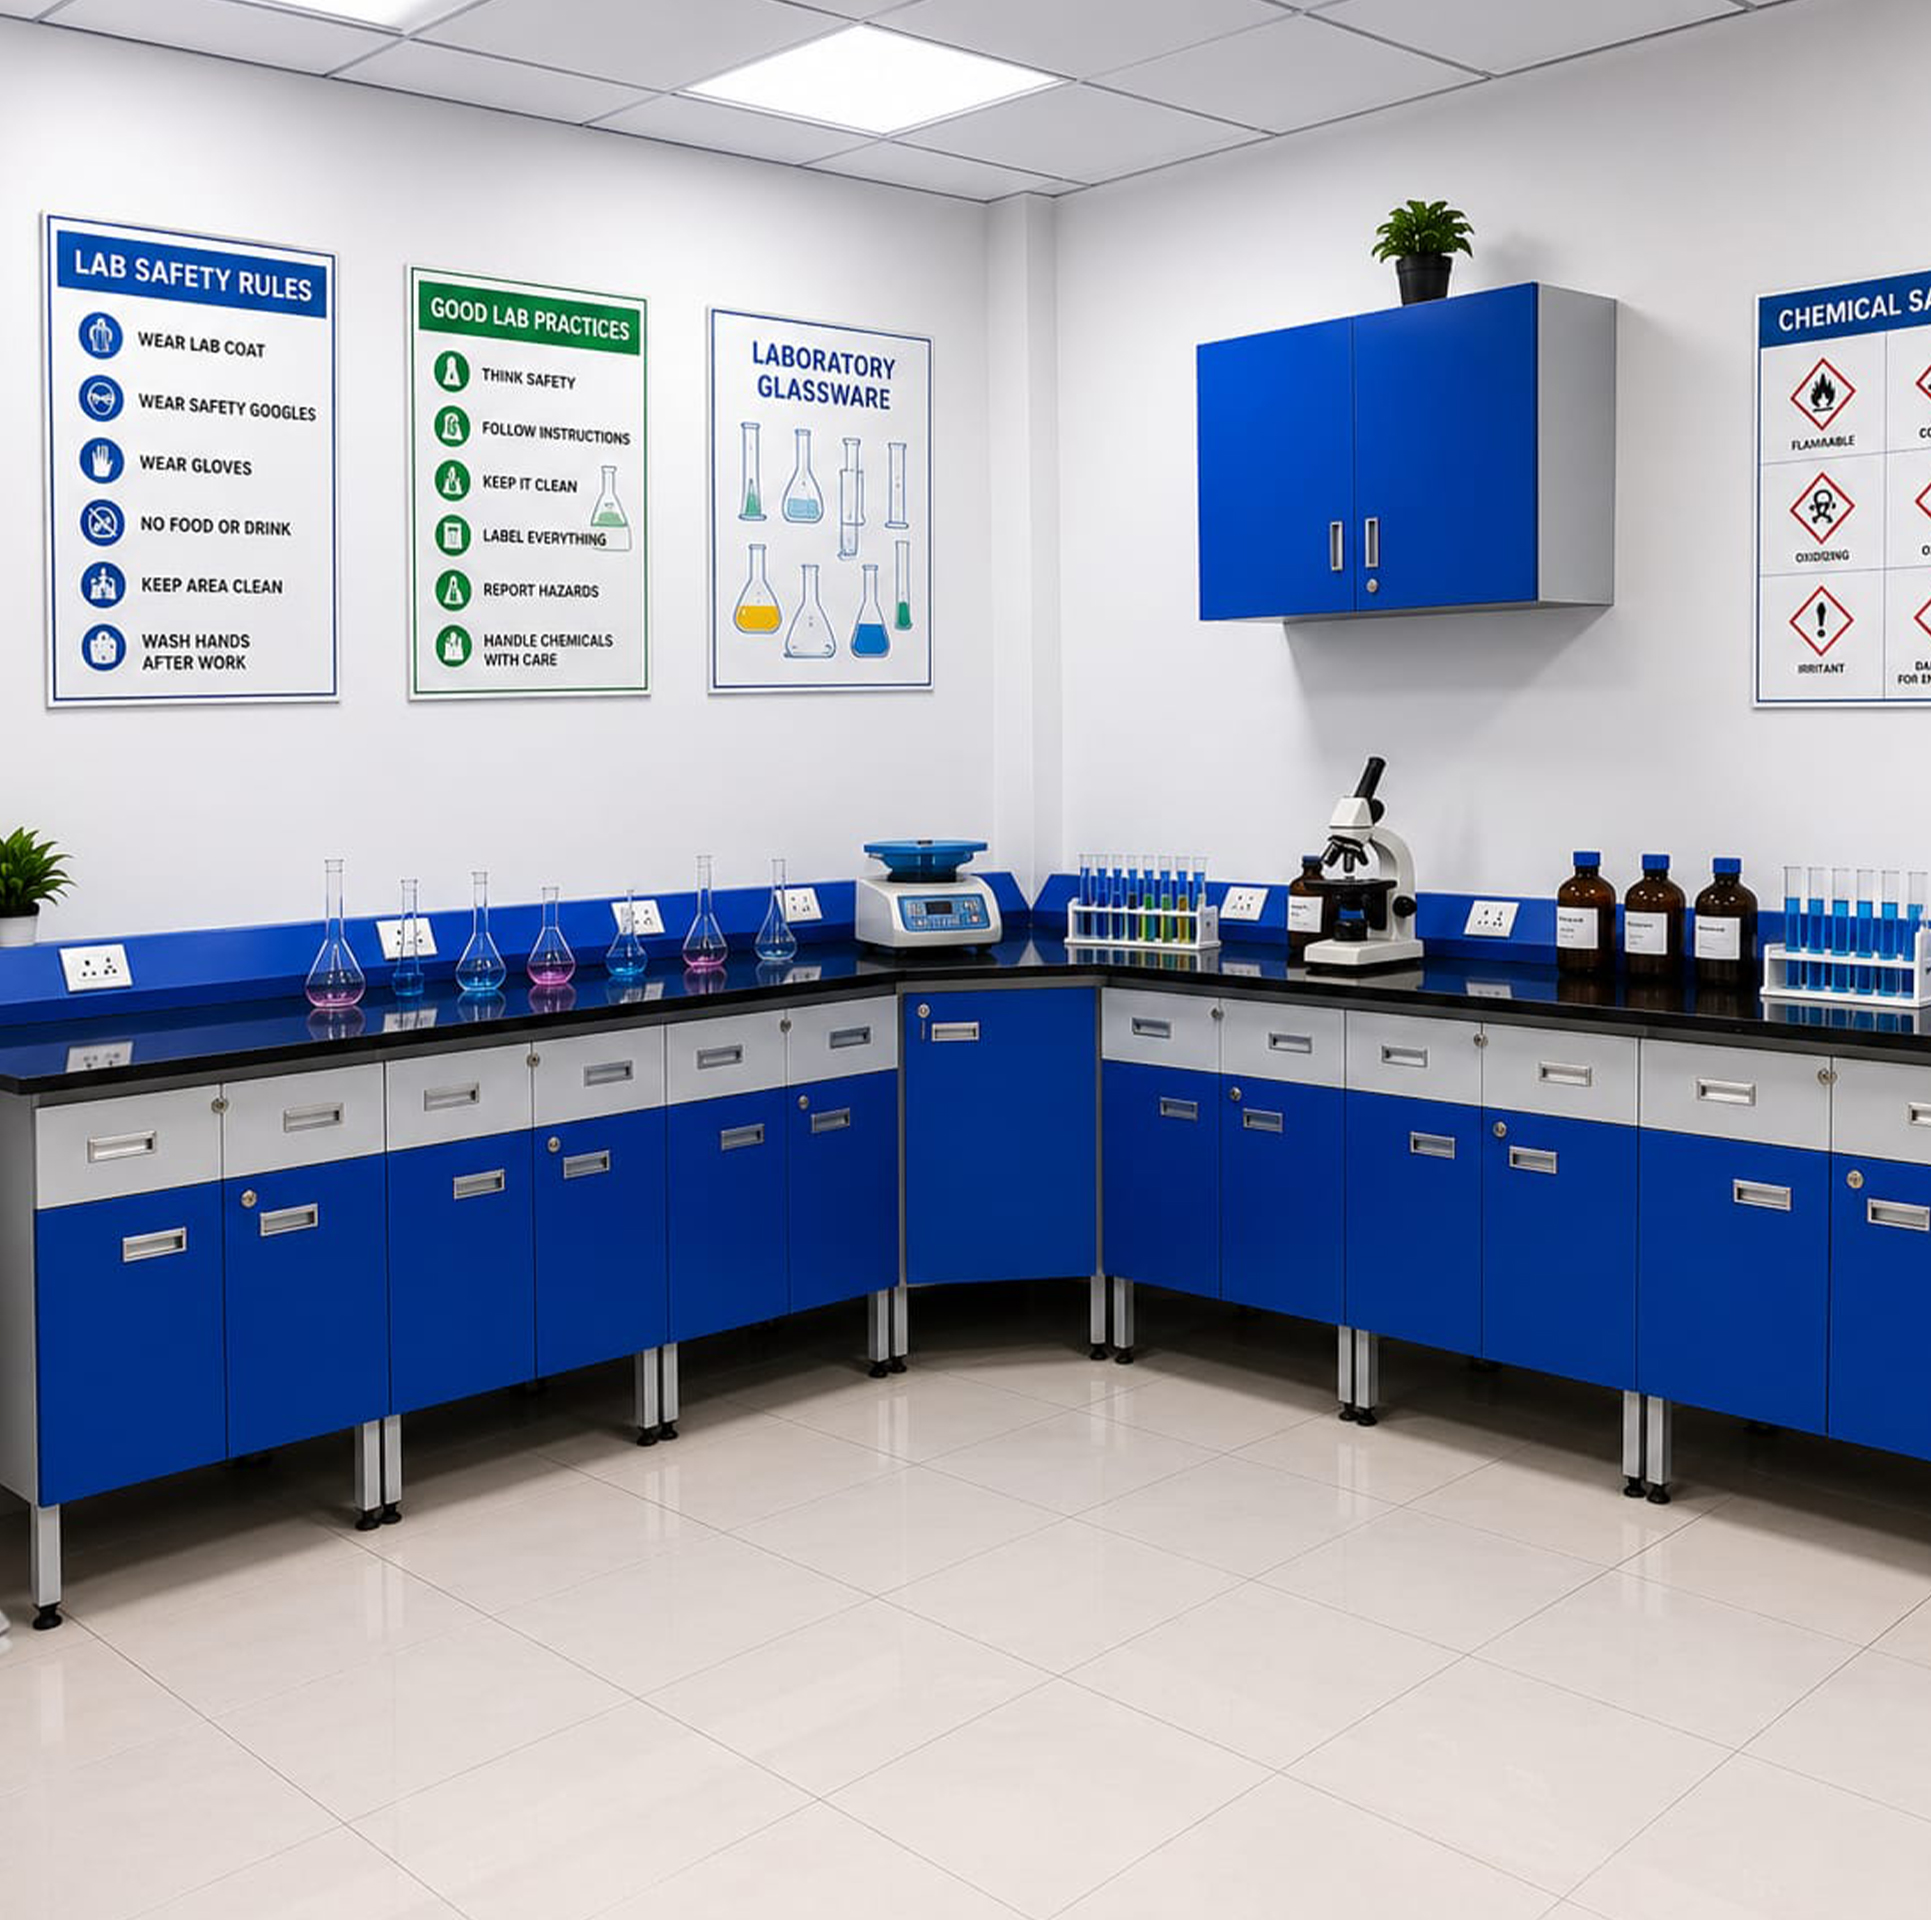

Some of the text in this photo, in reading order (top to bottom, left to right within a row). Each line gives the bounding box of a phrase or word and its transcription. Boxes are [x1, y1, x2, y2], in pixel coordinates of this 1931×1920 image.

[75, 249, 312, 302] LAB SAFETY RULES
[430, 297, 631, 341] GOOD LAB PRACTICES
[1778, 294, 1902, 331] CHEMICAL
[137, 331, 266, 358] WEAR LAB COAT
[753, 341, 895, 380] LABORATORY
[481, 367, 576, 390] THINK SAFETY
[758, 374, 891, 410] GLASSWARE
[138, 393, 317, 422] WEAR SAFETY GOOGLES
[482, 421, 631, 446] FOLLOW INSTRUCTIONS
[139, 454, 253, 476] WEAR GLOVES
[482, 475, 578, 493] KEEP IT CLEAN
[140, 516, 292, 536] NO FOOD OR DRINK
[483, 528, 607, 547] LABEL EVERYTHING
[141, 577, 283, 595] KEEP AREA CLEAN
[483, 582, 600, 599] REPORT HAZARDS
[141, 633, 251, 649] WASH HANDS
[483, 633, 614, 648] HANDLE CHEMICALS
[142, 654, 246, 671] AFTER WORK
[483, 652, 558, 667] WITH CARE
